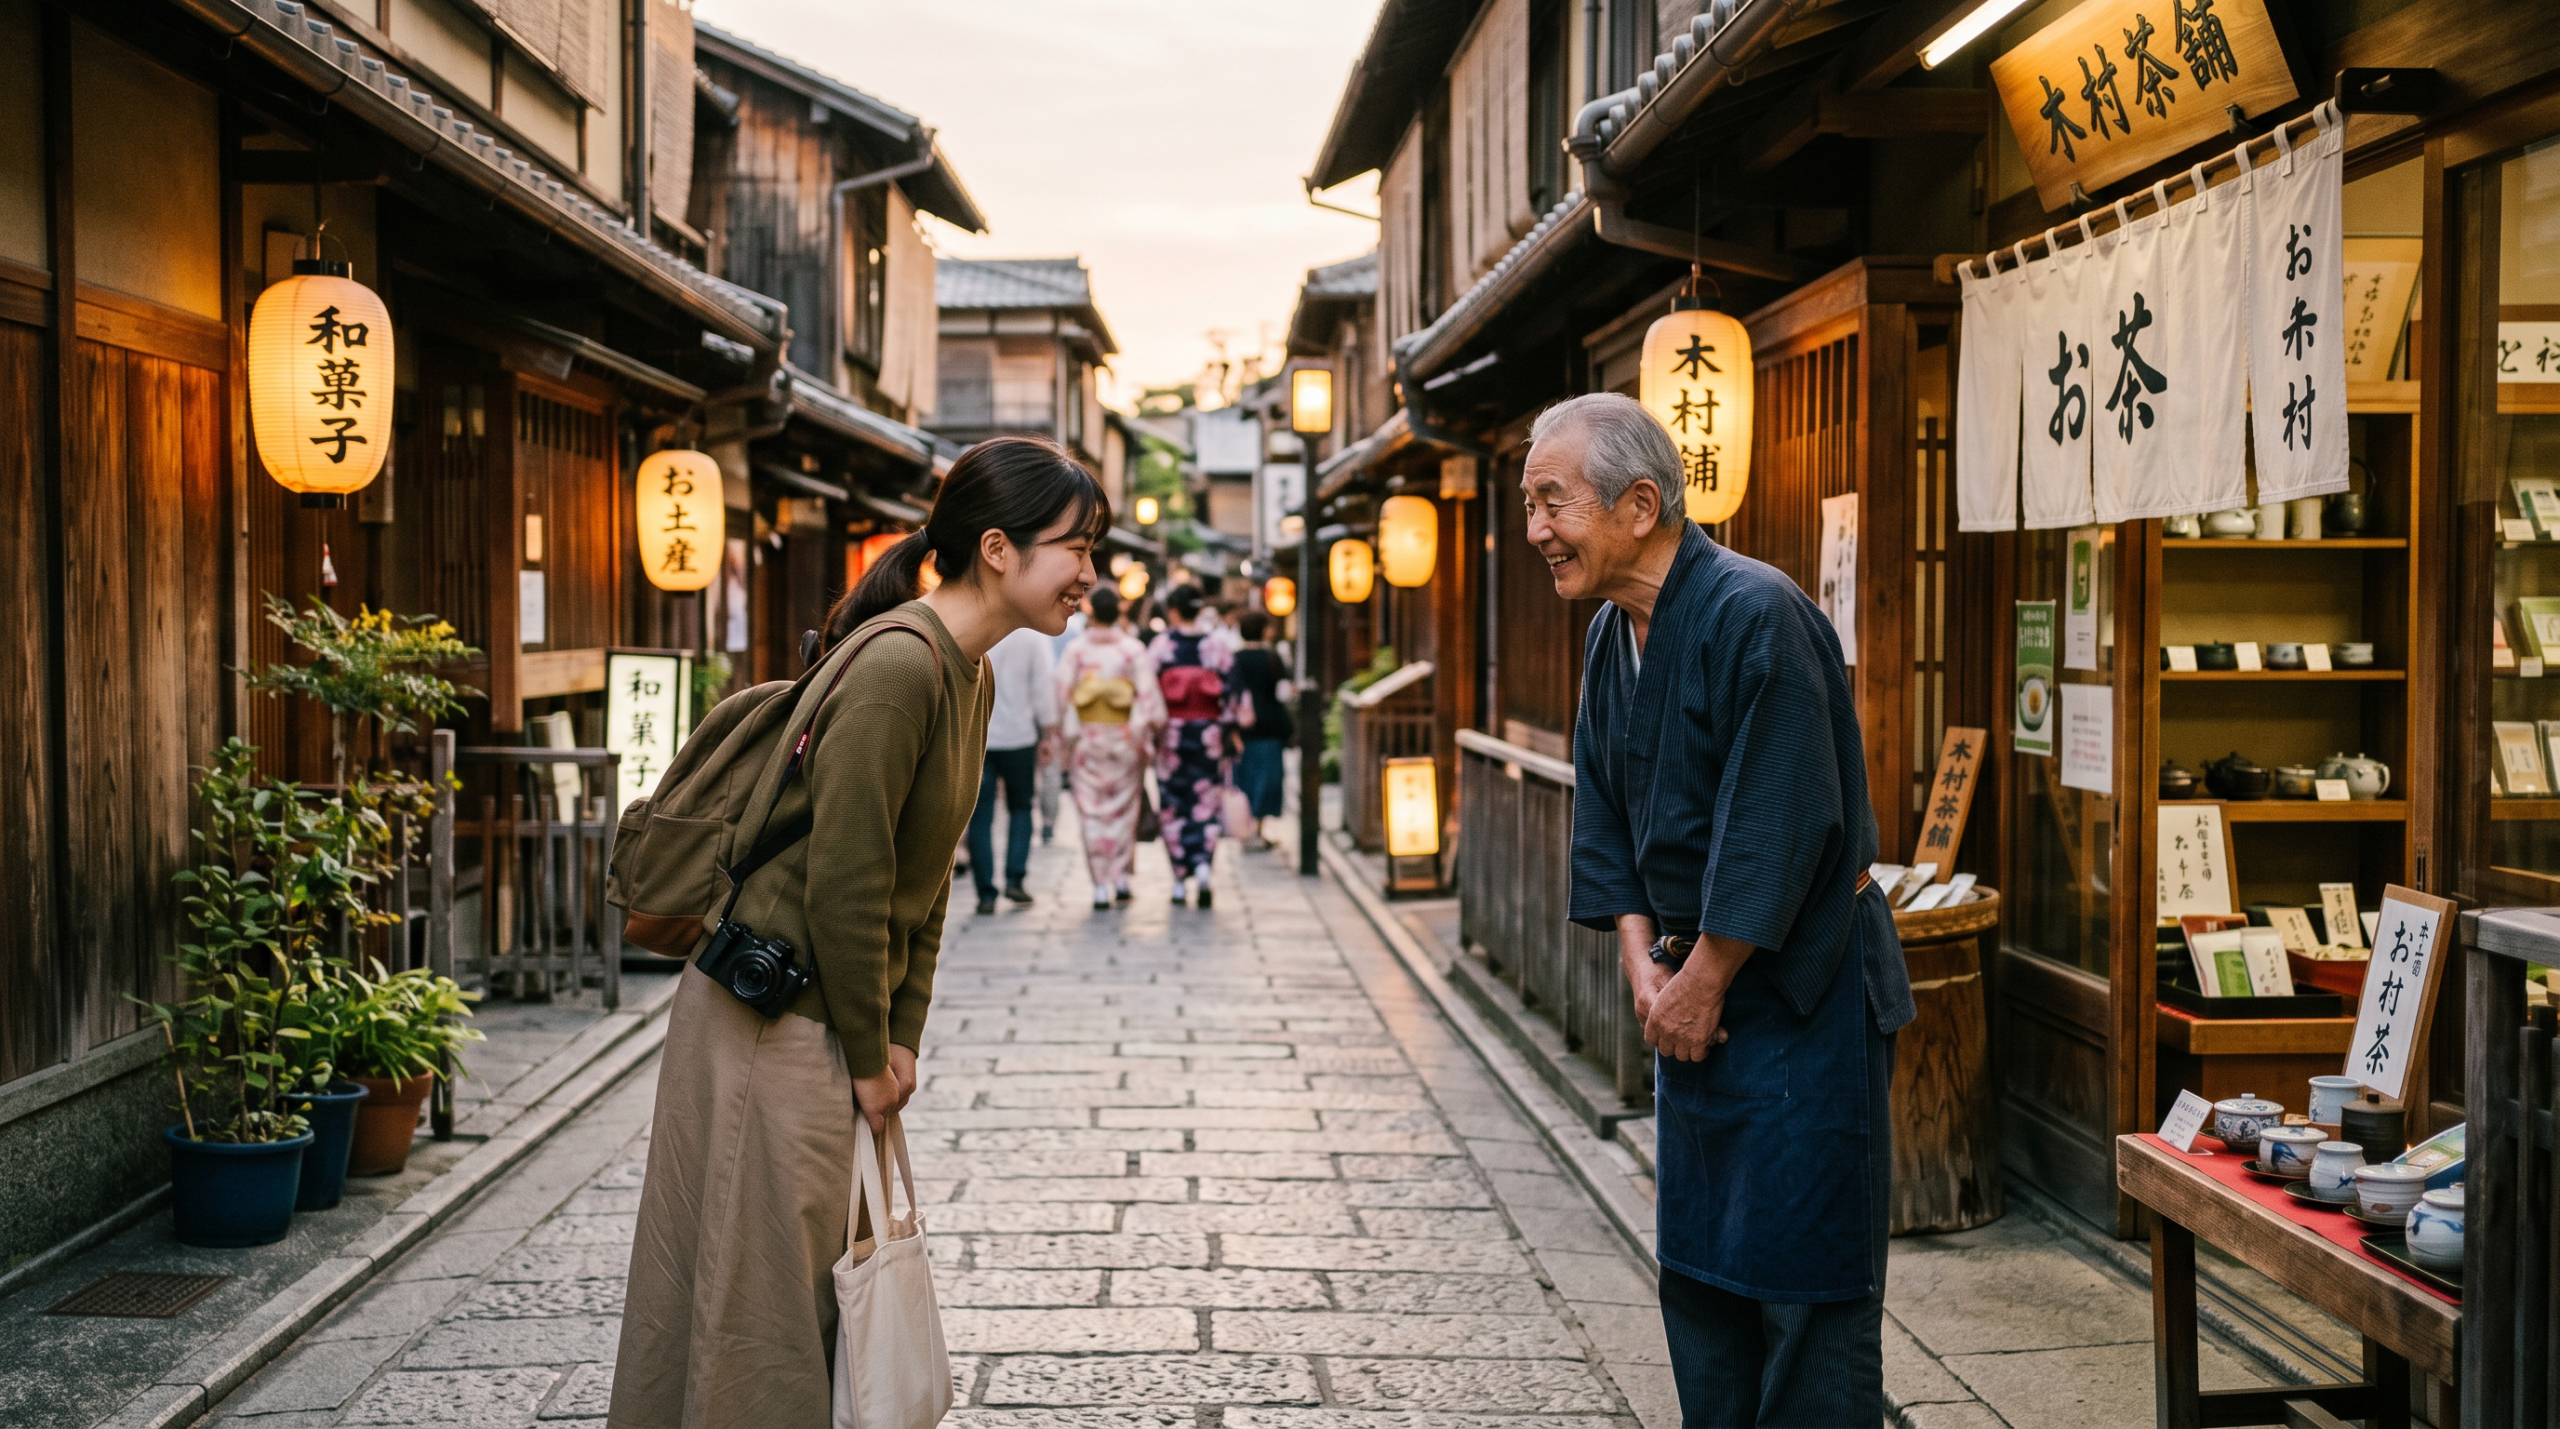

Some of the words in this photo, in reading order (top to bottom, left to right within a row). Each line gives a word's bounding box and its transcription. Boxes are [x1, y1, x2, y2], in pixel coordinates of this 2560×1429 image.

[2039, 0, 2238, 163] 木村茶舗
[306, 305, 369, 464] 和菓子
[2048, 291, 2168, 447] お茶
[661, 465, 698, 574] お土産
[623, 669, 661, 788] 和菓子
[2365, 920, 2414, 1076] お村茶
